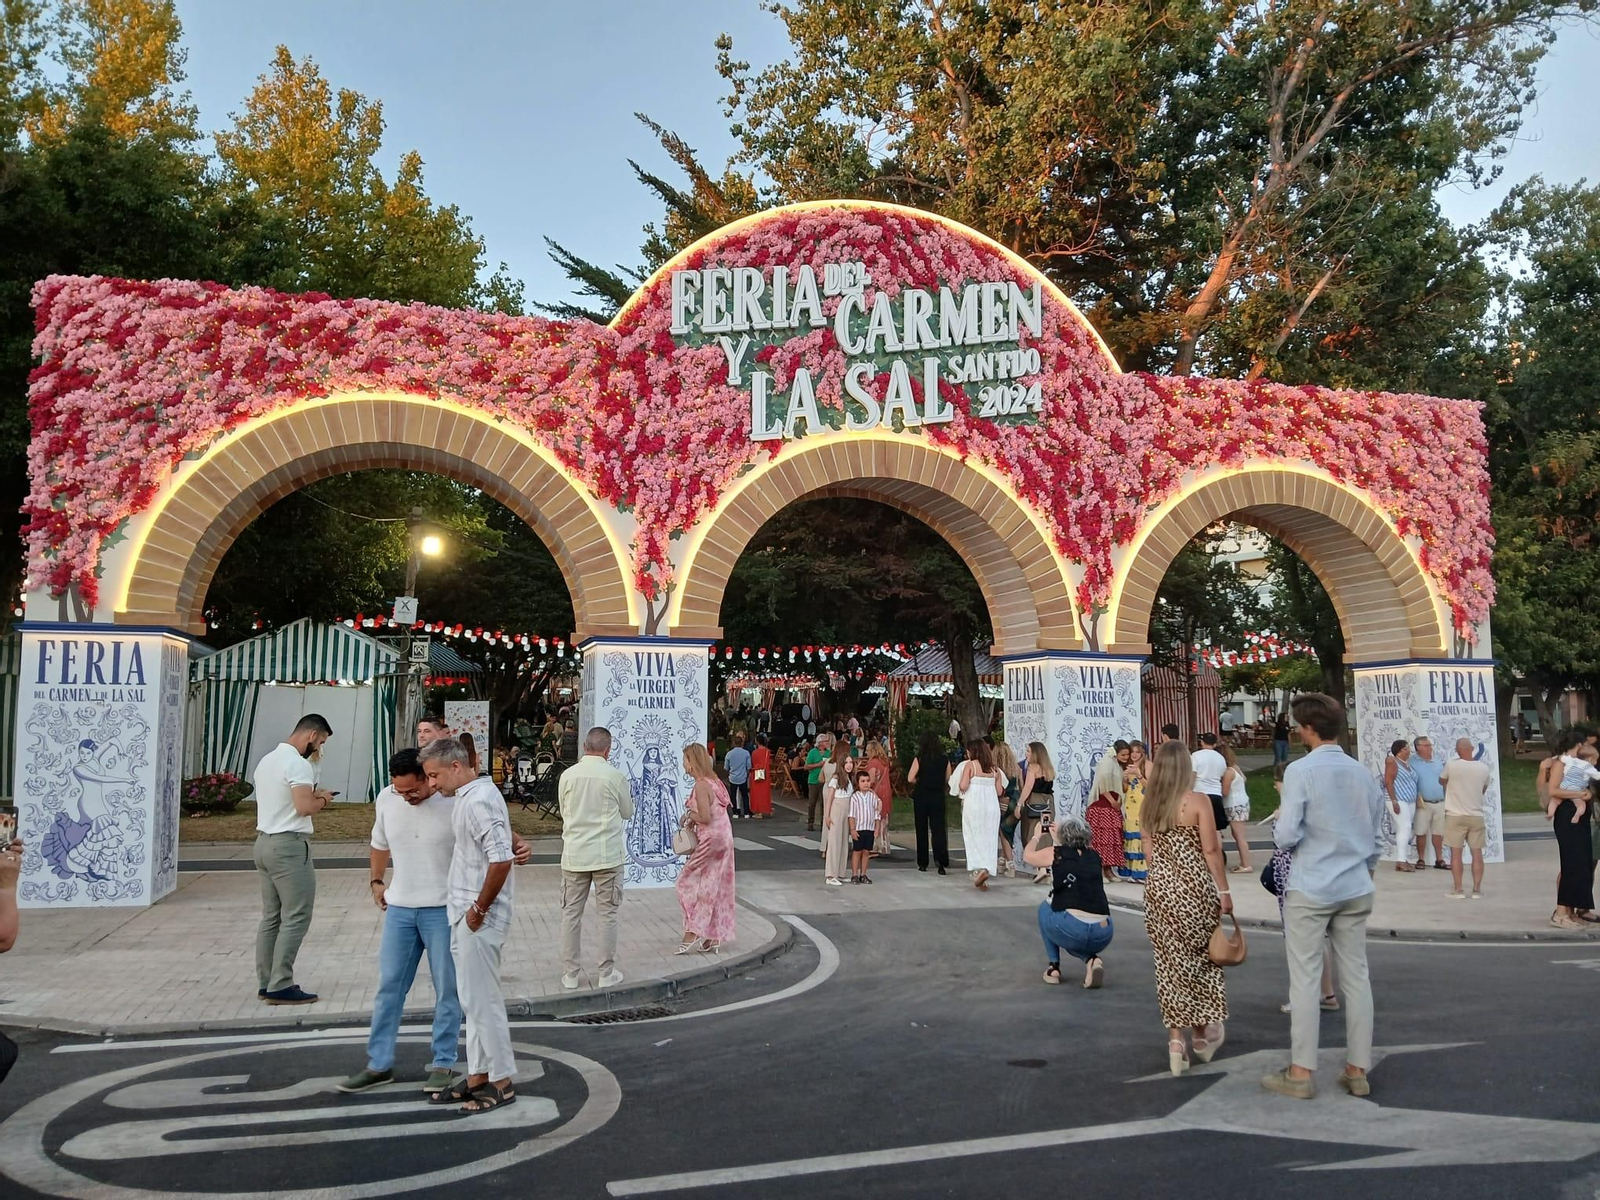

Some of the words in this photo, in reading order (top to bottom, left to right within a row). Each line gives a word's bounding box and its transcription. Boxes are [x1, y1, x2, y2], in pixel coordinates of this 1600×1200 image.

[669, 264, 828, 335] FERIA
[823, 261, 871, 297] DEL
[834, 281, 1042, 356] CARMEN
[719, 334, 751, 386] Y
[947, 354, 993, 384] SAN
[996, 348, 1041, 379] FDO
[750, 367, 826, 442] LA
[844, 356, 954, 433] SAL
[979, 382, 1044, 418] 2024
[35, 639, 147, 685] FERIA
[634, 651, 676, 677] VIVA
[637, 679, 676, 694] VIRGEN
[1008, 665, 1045, 701] FERIA
[1079, 665, 1114, 688] VIVA
[1374, 673, 1400, 694] VIVA
[1428, 670, 1488, 703] FERIA
[34, 690, 45, 699] DEL
[49, 687, 91, 702] CARMEN
[112, 688, 124, 702] LA
[127, 688, 145, 702] SAL
[638, 696, 676, 709] CARMEN
[1082, 691, 1114, 703] VIRGEN
[1377, 695, 1401, 708] VIRGEN
[1084, 706, 1115, 718] CARMEN
[1379, 709, 1402, 720] CARMEN
[1437, 705, 1460, 715] CARMEN
